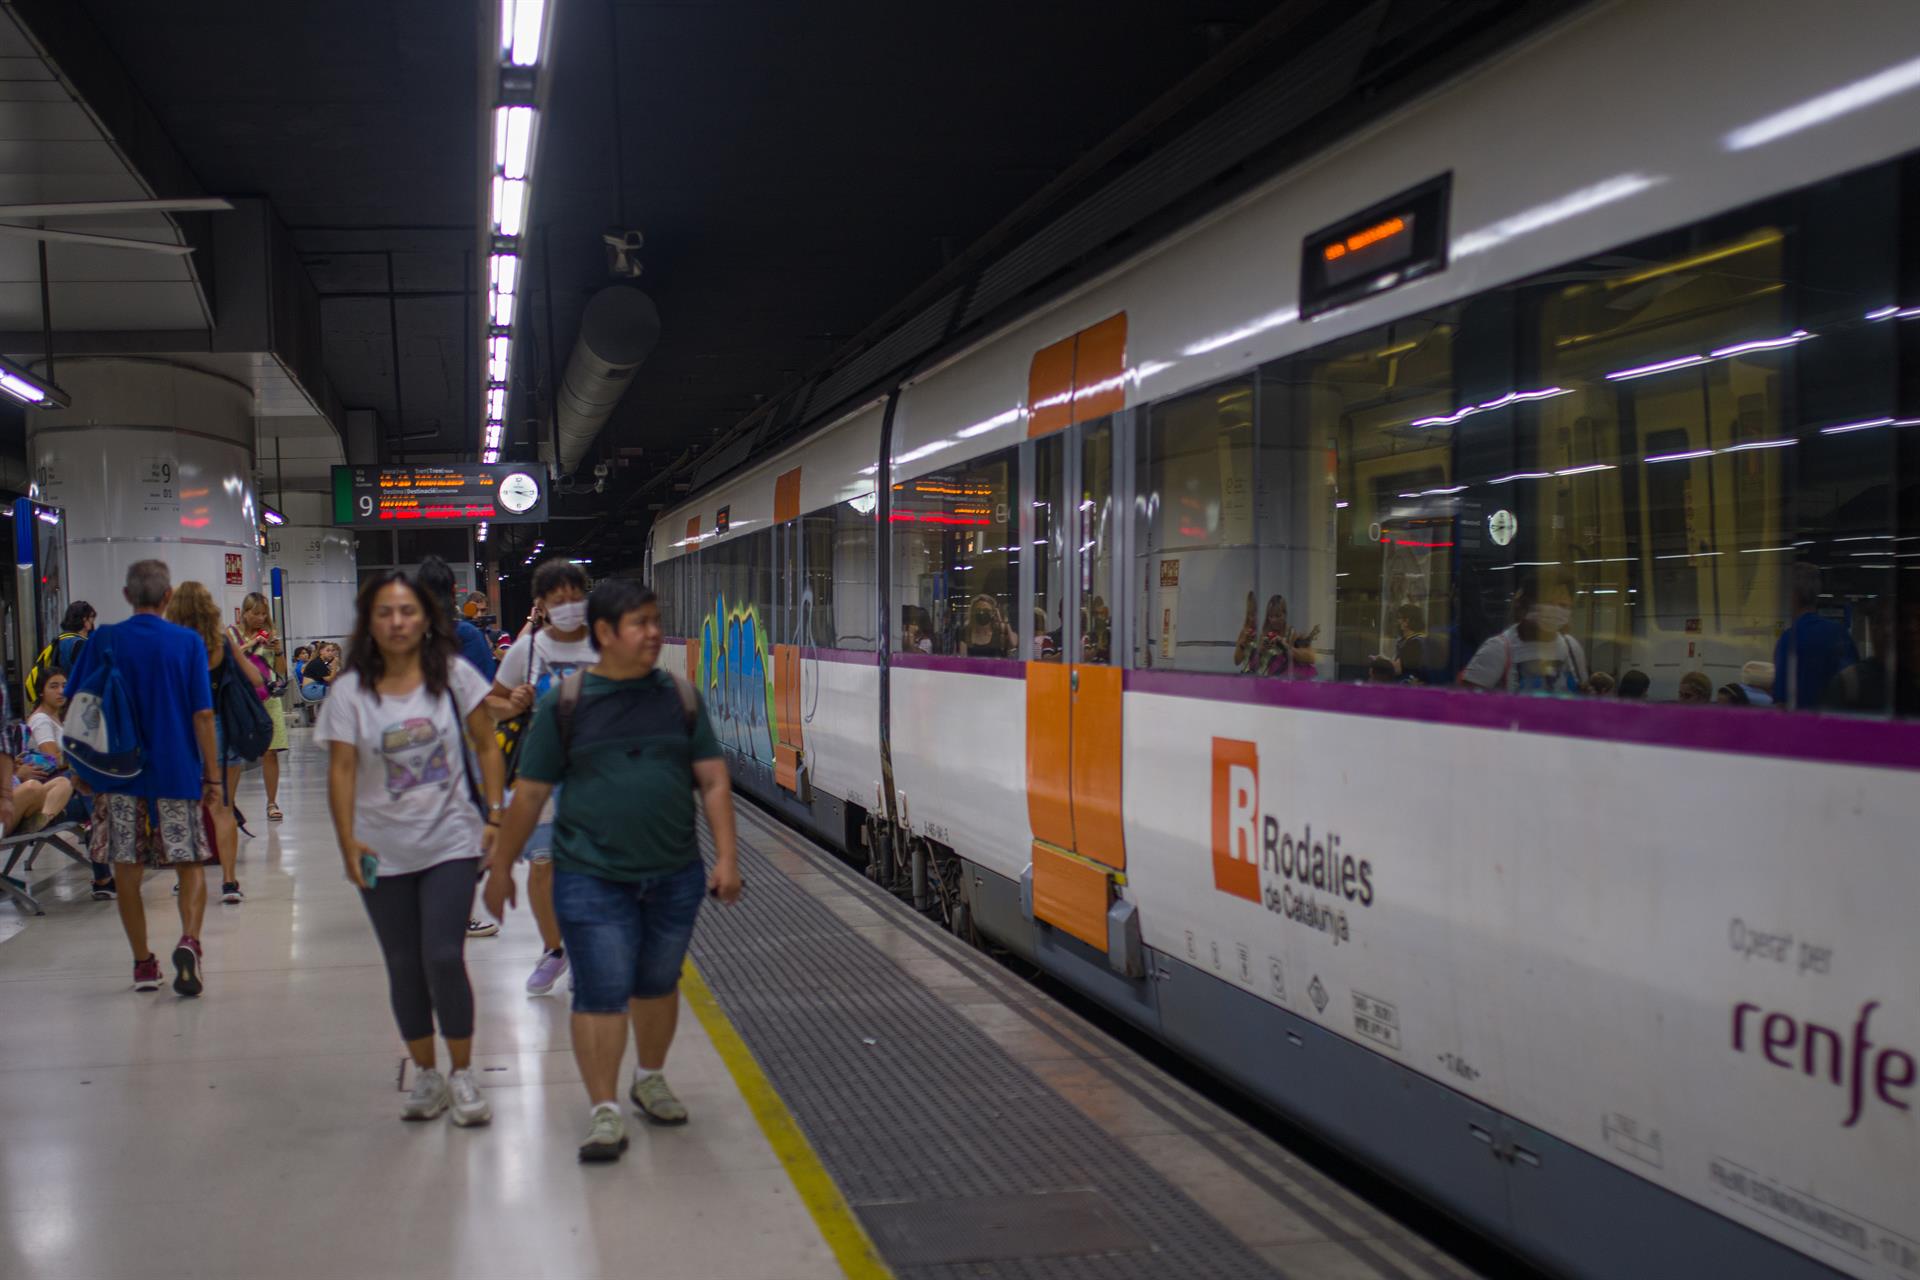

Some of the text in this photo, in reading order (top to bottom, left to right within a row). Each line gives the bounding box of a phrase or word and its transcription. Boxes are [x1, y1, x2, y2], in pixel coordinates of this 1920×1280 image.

[161, 463, 172, 484] 9
[359, 495, 374, 517] 9
[1229, 764, 1259, 865] R
[1264, 814, 1374, 908] Rodalies
[1264, 882, 1350, 946] de Catalunya
[1731, 999, 1917, 1128] renfe
